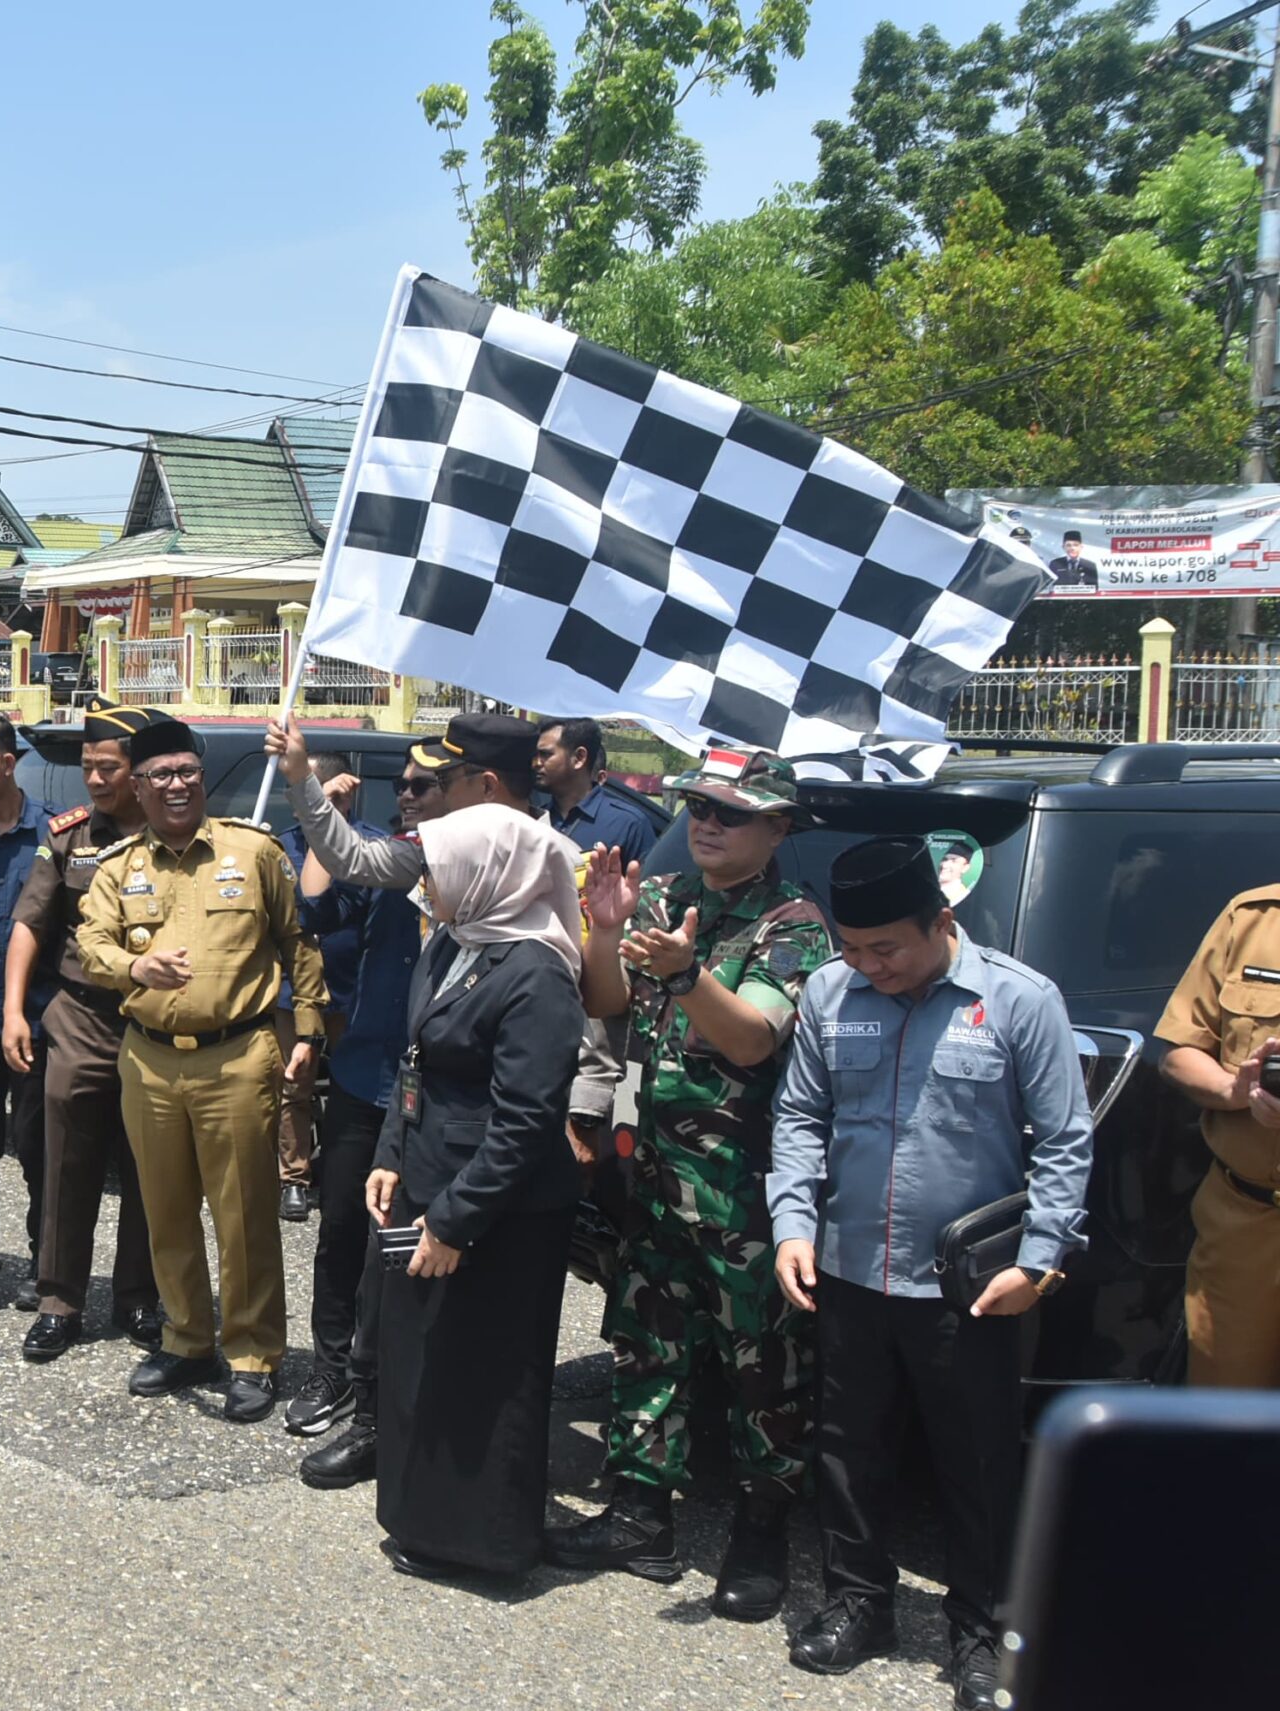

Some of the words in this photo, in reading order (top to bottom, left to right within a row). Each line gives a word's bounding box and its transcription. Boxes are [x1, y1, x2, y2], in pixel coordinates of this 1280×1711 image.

[1115, 526, 1160, 534] KABUPATEN
[1117, 540, 1155, 550] LAPOR
[1157, 538, 1206, 549] MELALUI
[1101, 552, 1227, 568] www.lapor.go.id
[1109, 571, 1145, 583] SMS
[1151, 571, 1168, 583] ke
[1175, 569, 1217, 583] 1708
[822, 1023, 876, 1035] MUDRIKA
[947, 1025, 996, 1040] BAWASLU
